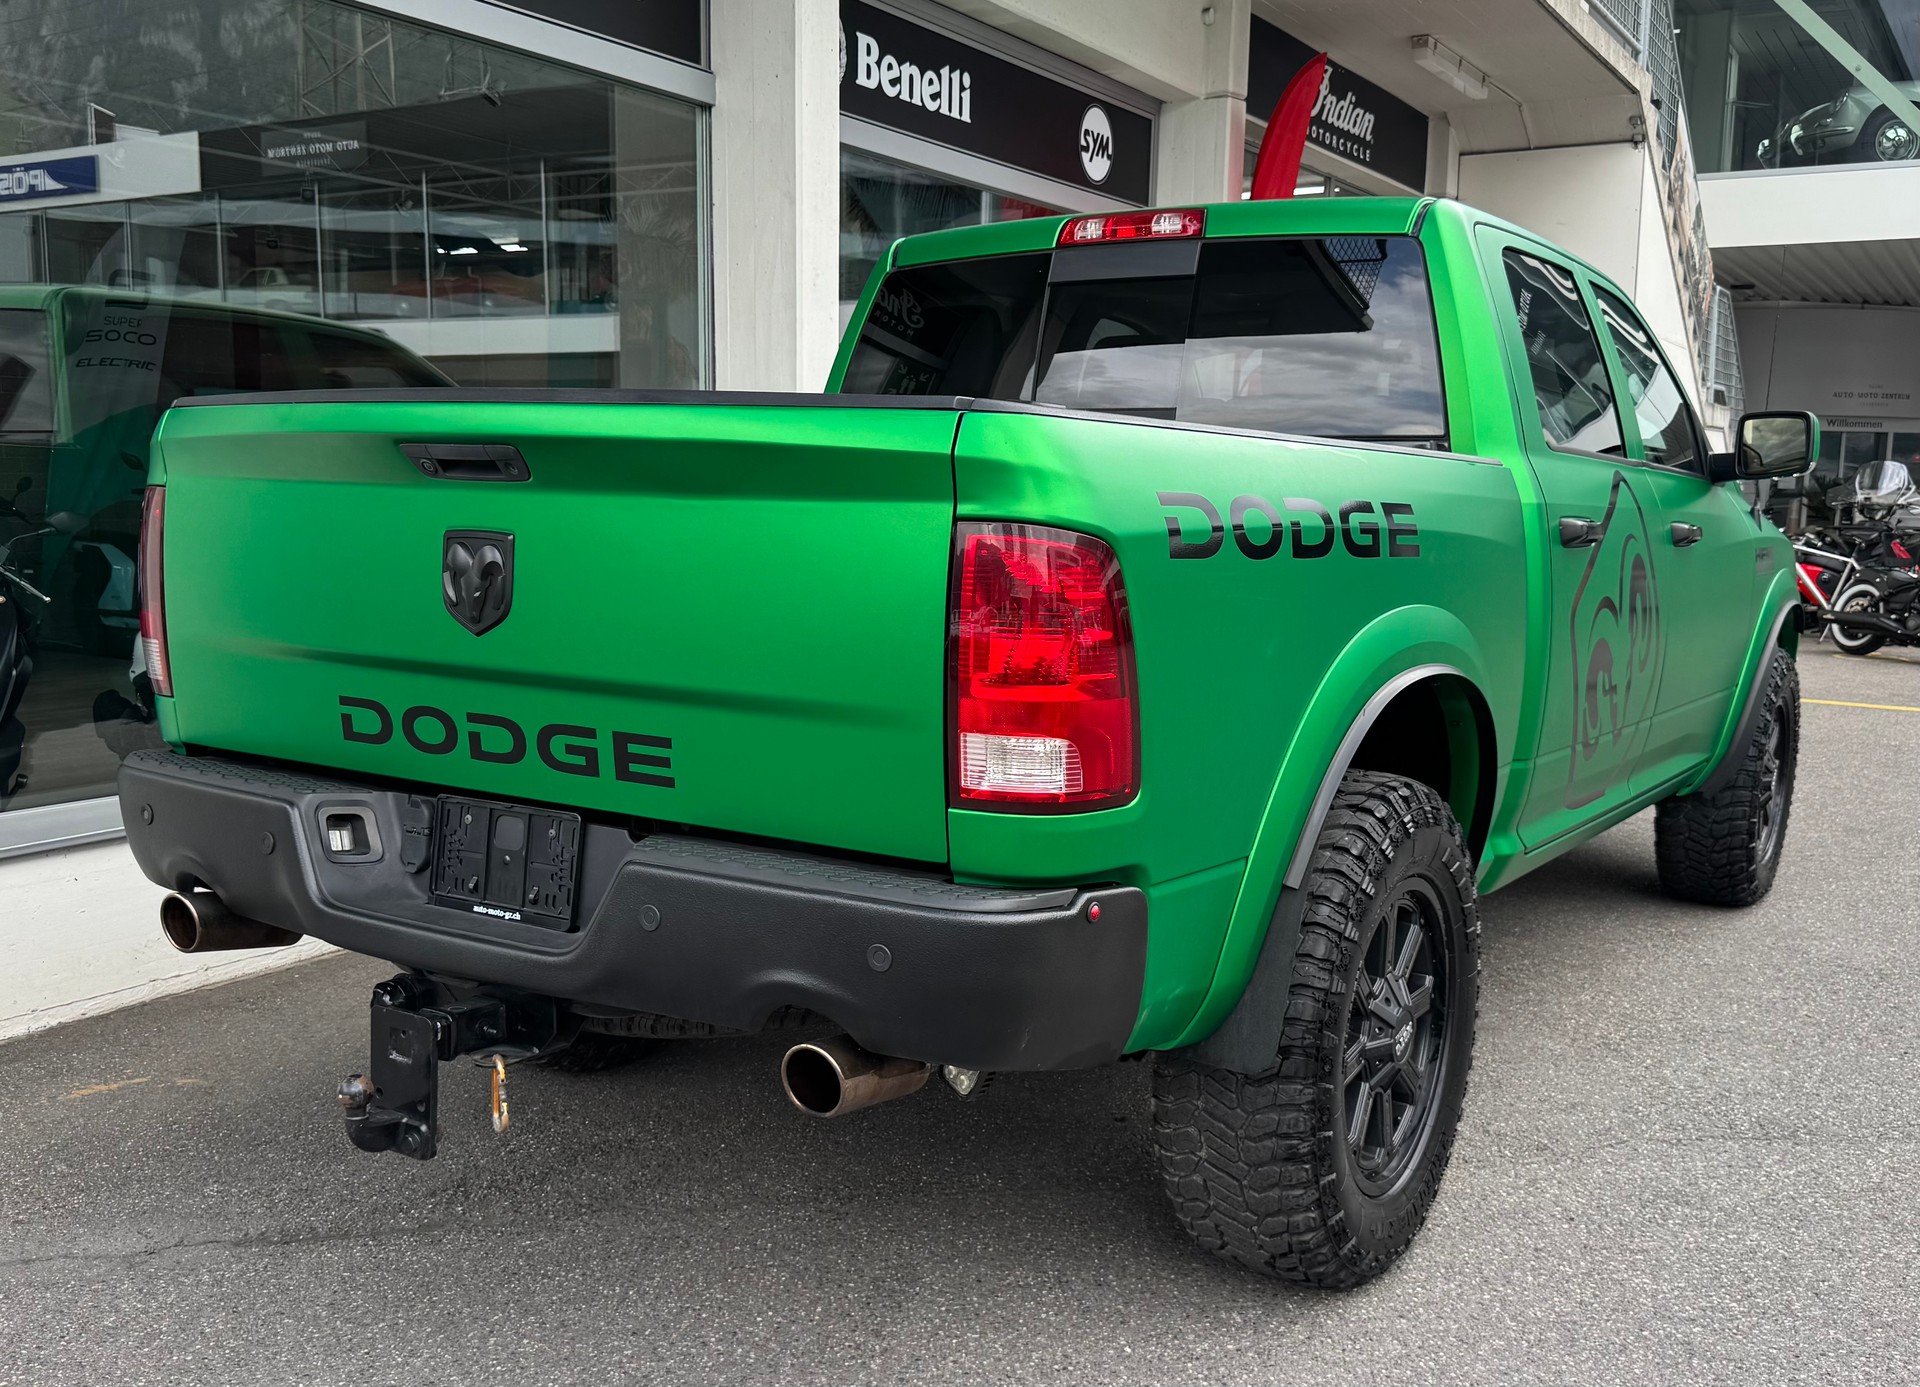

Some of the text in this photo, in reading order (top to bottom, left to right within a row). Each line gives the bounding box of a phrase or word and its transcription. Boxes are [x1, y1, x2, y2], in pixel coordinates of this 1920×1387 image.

[856, 31, 971, 123] Benelli
[1310, 65, 1374, 141] Indian
[1080, 128, 1112, 162] SYM
[1306, 124, 1370, 161] OTORCYCLE
[85, 330, 157, 345] SOCO
[76, 357, 157, 372] ELECTRIC
[1826, 418, 1883, 428] Willkommen
[1156, 491, 1420, 560] DODGE
[338, 695, 676, 789] DODGE
